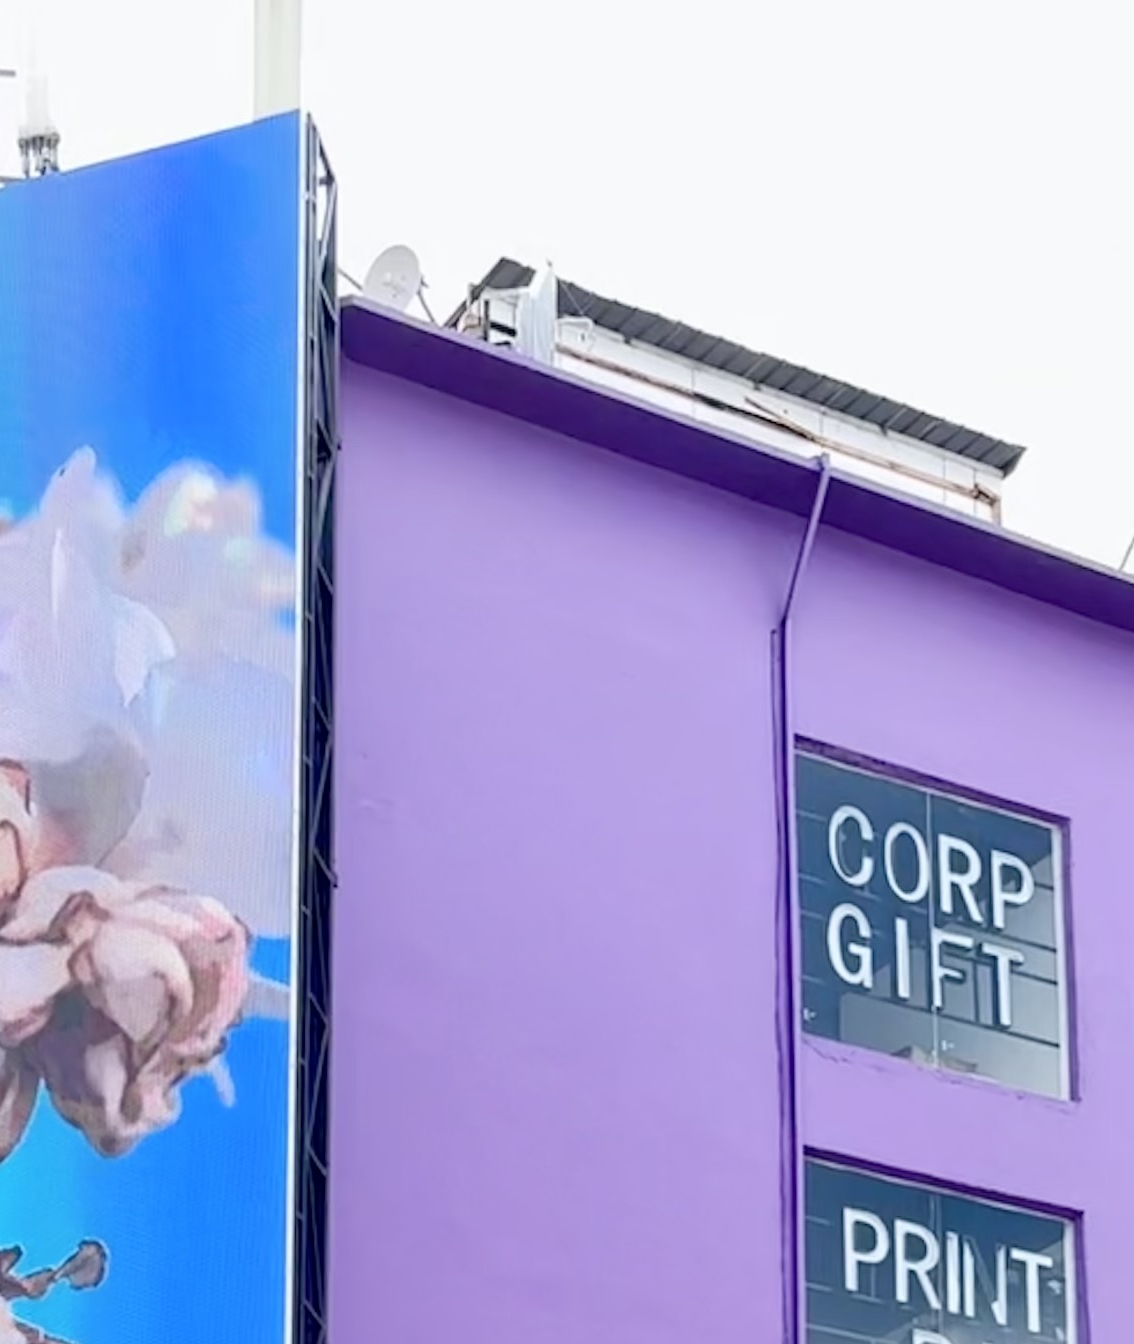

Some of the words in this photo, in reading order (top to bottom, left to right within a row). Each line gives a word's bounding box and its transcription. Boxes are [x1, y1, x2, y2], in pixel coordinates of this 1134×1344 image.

[828, 805, 1035, 930] CORP
[827, 903, 1026, 1028] GIFT
[842, 1207, 1054, 1333] PRINT
